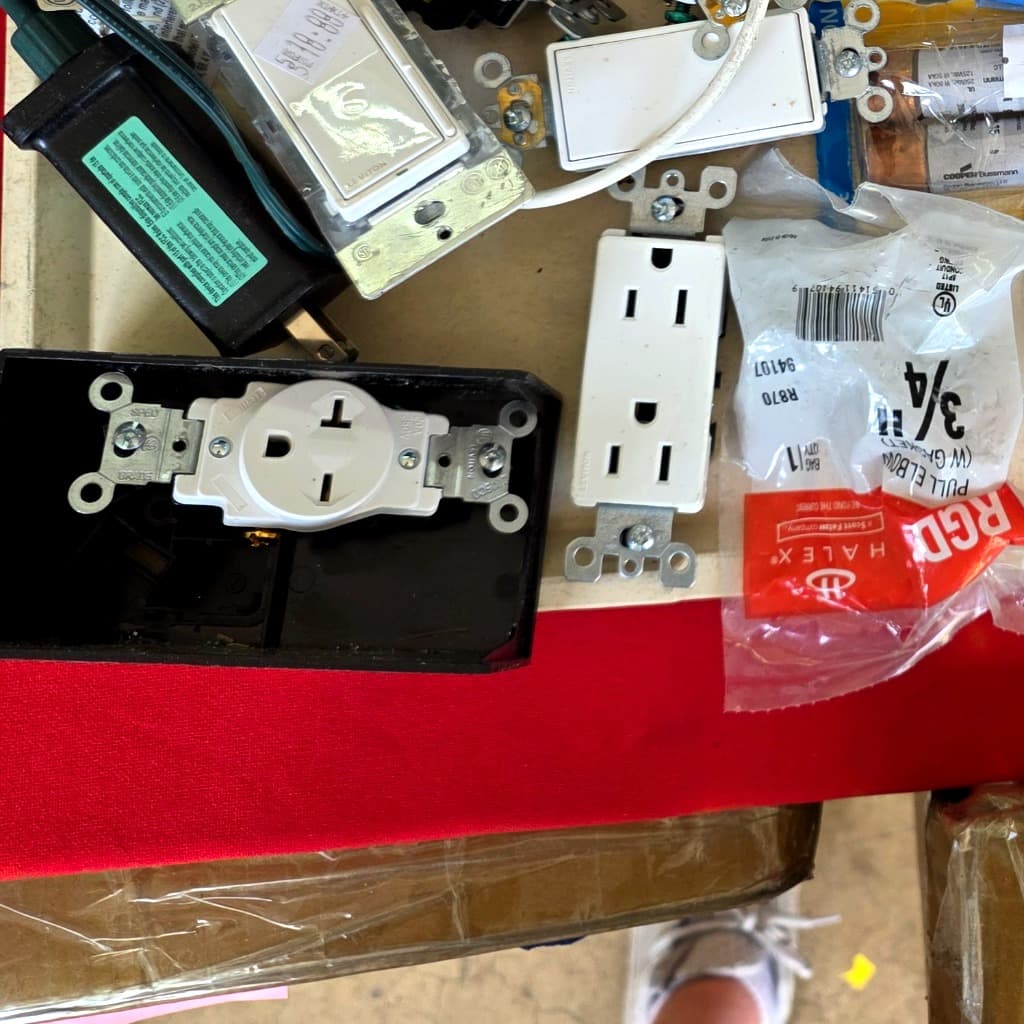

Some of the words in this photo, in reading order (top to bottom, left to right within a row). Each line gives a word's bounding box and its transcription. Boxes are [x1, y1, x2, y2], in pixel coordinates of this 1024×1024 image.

[754, 357, 797, 377] 94107
[761, 387, 799, 406] R870
[786, 446, 798, 472] 1
[806, 457, 820, 472] BAG
[929, 474, 970, 498] PULL
[844, 521, 866, 531] Scott
[910, 490, 1012, 563] RGD
